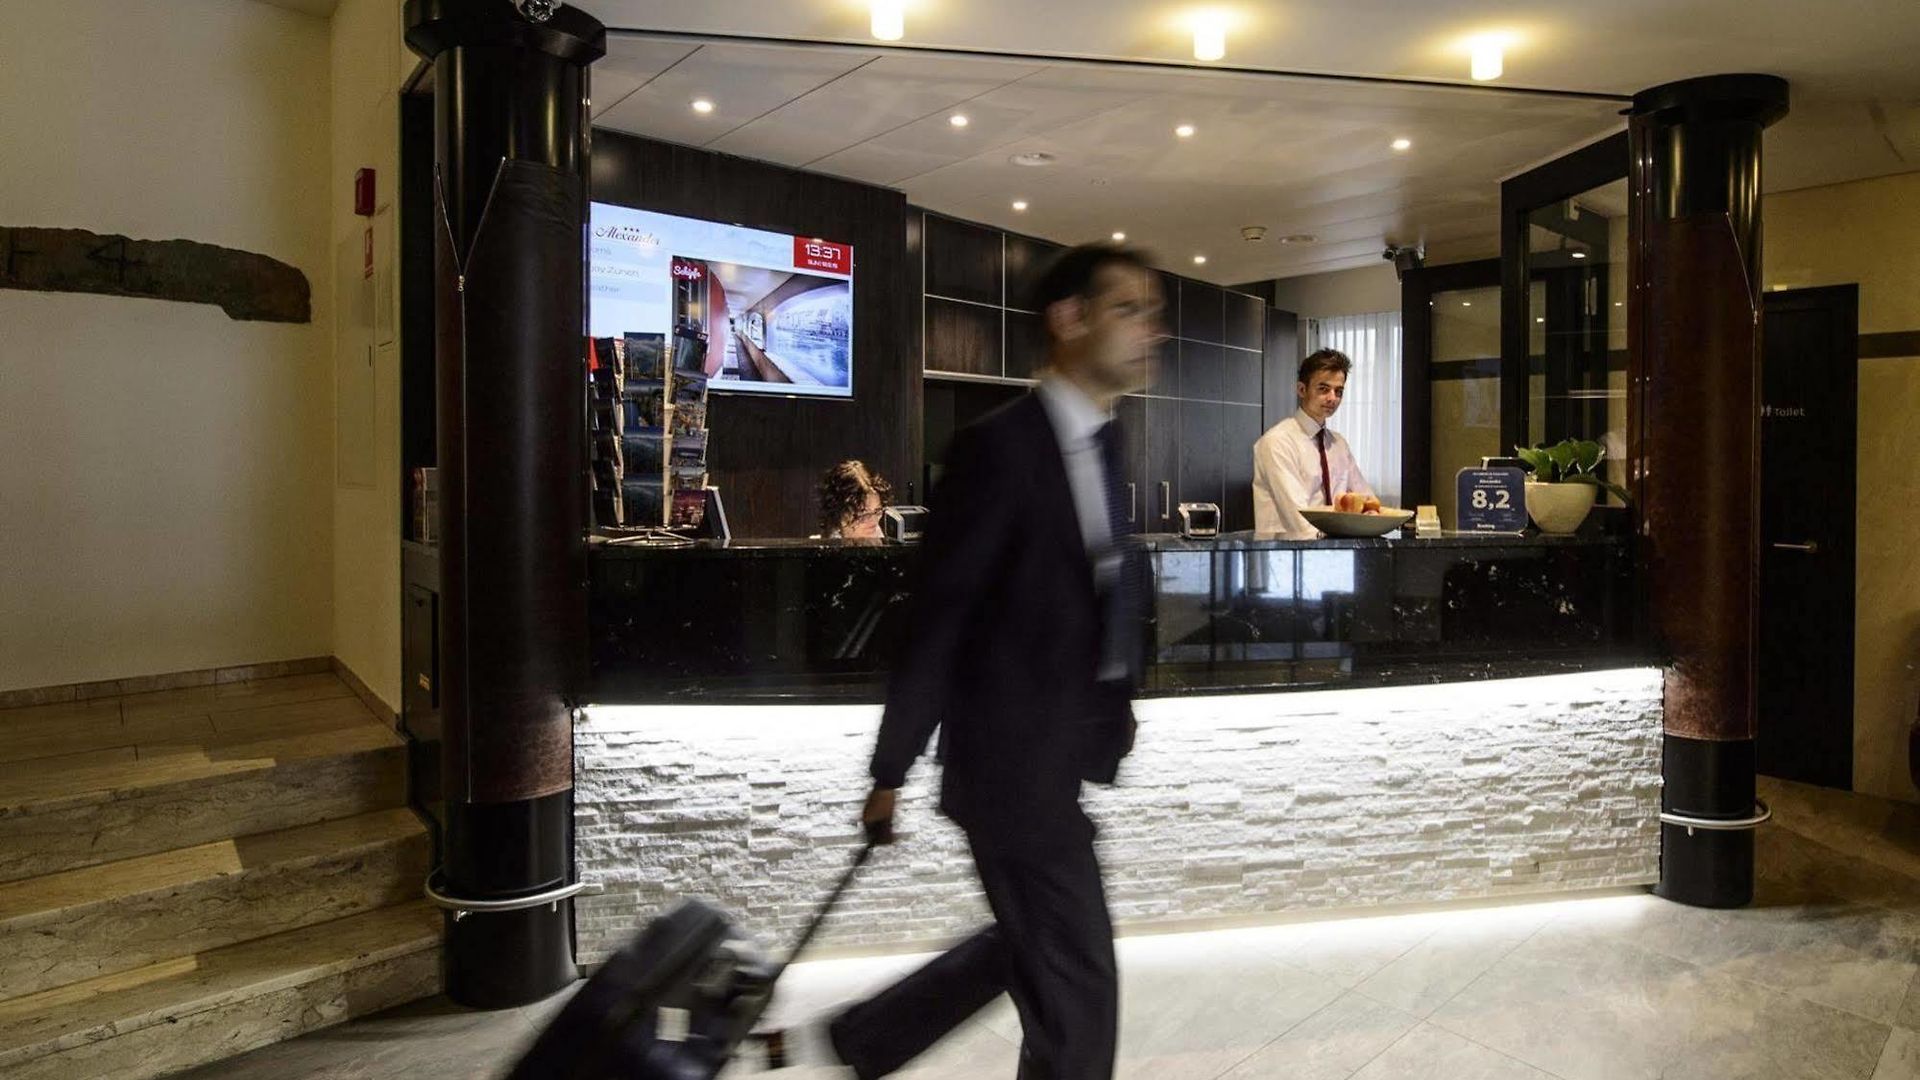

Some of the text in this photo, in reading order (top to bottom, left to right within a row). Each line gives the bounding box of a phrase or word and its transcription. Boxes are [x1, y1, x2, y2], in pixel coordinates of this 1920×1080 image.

[594, 226, 660, 245] Alexander
[804, 243, 841, 260] 13:37
[1775, 407, 1806, 417] Toilet
[1472, 489, 1510, 510] 8,2
